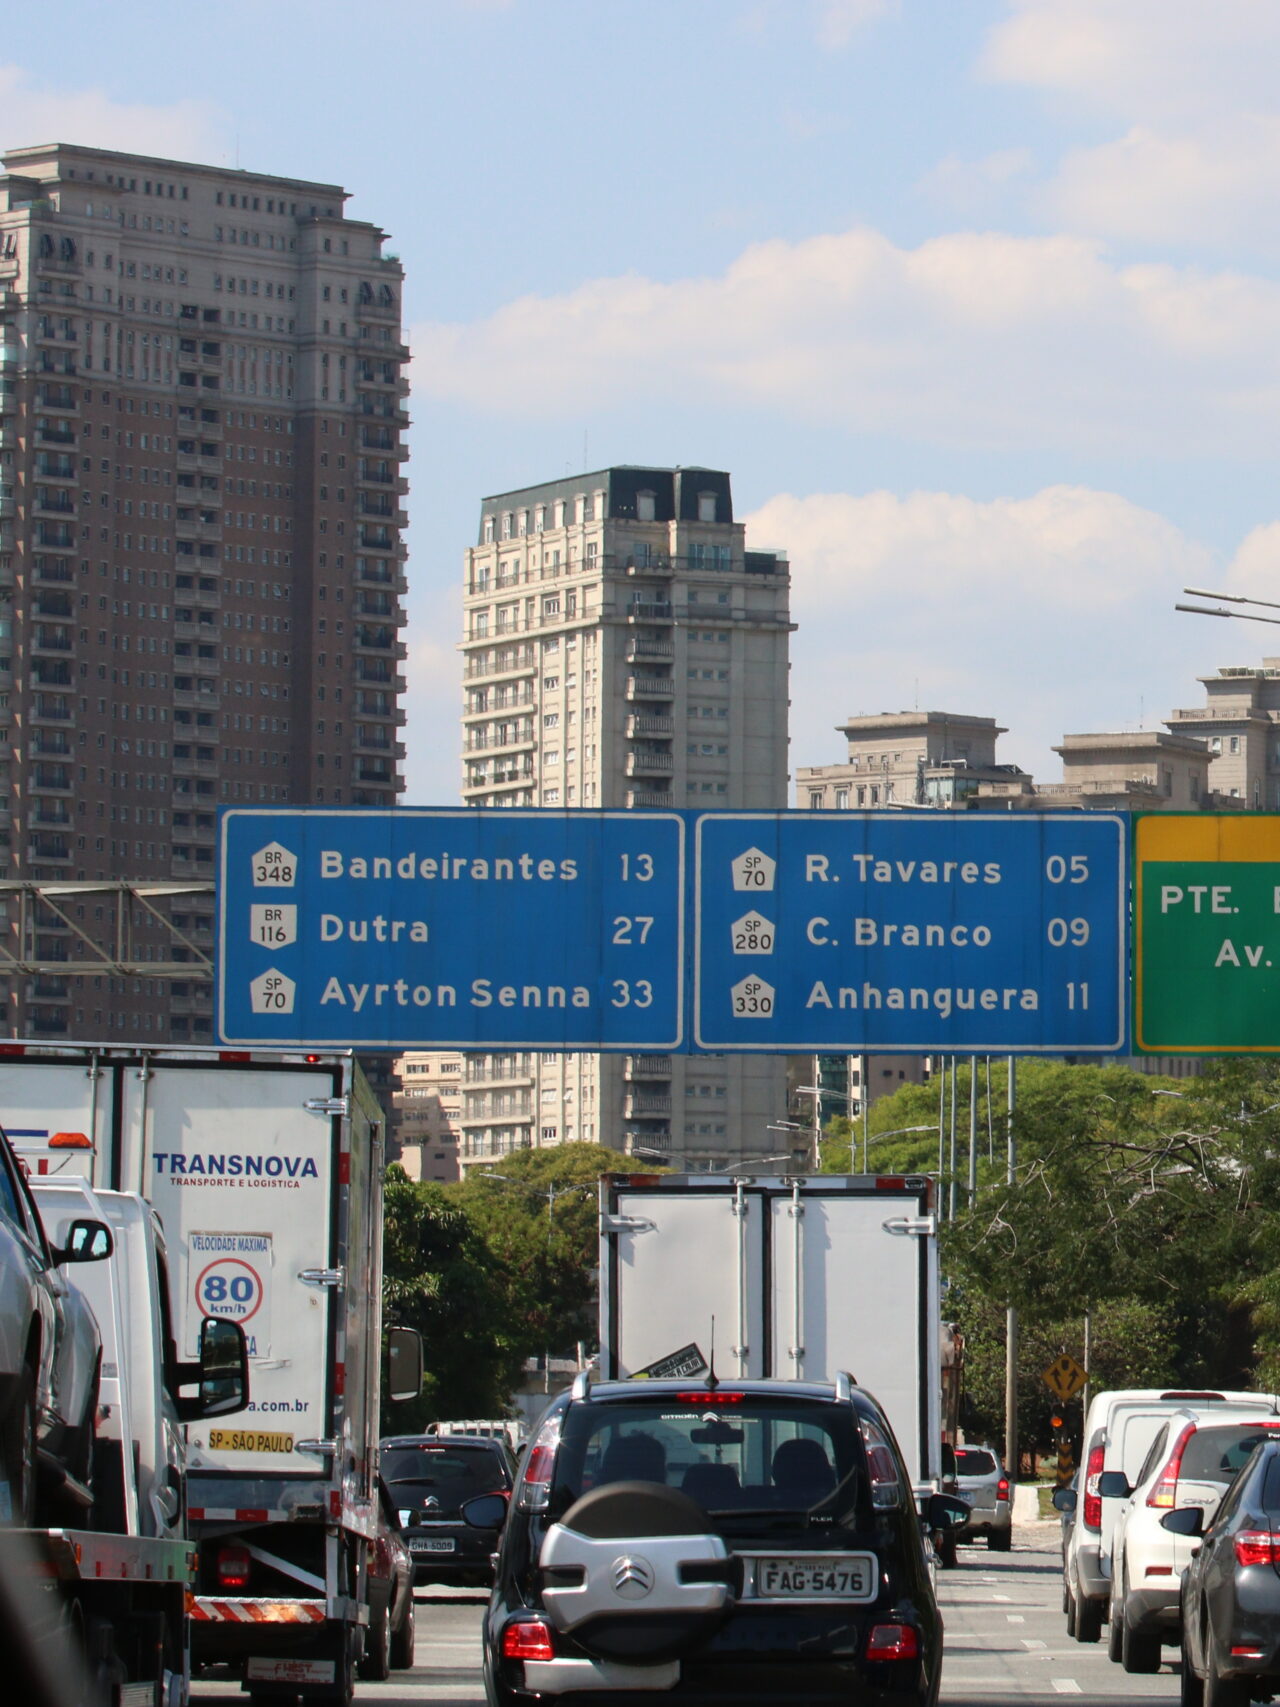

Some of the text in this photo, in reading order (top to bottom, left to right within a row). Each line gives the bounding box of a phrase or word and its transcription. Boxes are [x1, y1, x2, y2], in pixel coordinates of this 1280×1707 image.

[265, 851, 282, 864] BR
[745, 856, 761, 869] SP
[256, 866, 292, 882] 348
[321, 851, 654, 882] Bandeirantes 13
[806, 854, 1090, 884] R. Tavares 05
[742, 870, 766, 886] 70
[1161, 886, 1240, 915] PTE.
[265, 909, 282, 921] BR
[260, 926, 287, 942] 116
[320, 914, 654, 945] Dutra 27
[745, 920, 761, 932] SP
[806, 917, 1090, 947] C. Branco 09
[735, 934, 772, 950] 280
[1214, 939, 1273, 968] Av.
[265, 977, 282, 990] SP
[745, 983, 761, 995] SP
[262, 992, 286, 1008] 70
[320, 976, 654, 1012] Ayrton Senna 33
[806, 981, 1089, 1019] Anhanguera 11
[735, 997, 772, 1013] 330
[152, 1153, 319, 1178] TRANSNOVA
[170, 1177, 236, 1187] TRANSPORTE
[239, 1179, 245, 1187] E
[192, 1236, 236, 1252] VELOCIDADE
[204, 1275, 254, 1302] 80
[210, 1303, 247, 1314] km/h
[248, 1399, 309, 1412] a.com.br
[209, 1432, 223, 1448] SP
[232, 1431, 255, 1451] SÃO
[257, 1435, 294, 1453] PAULO
